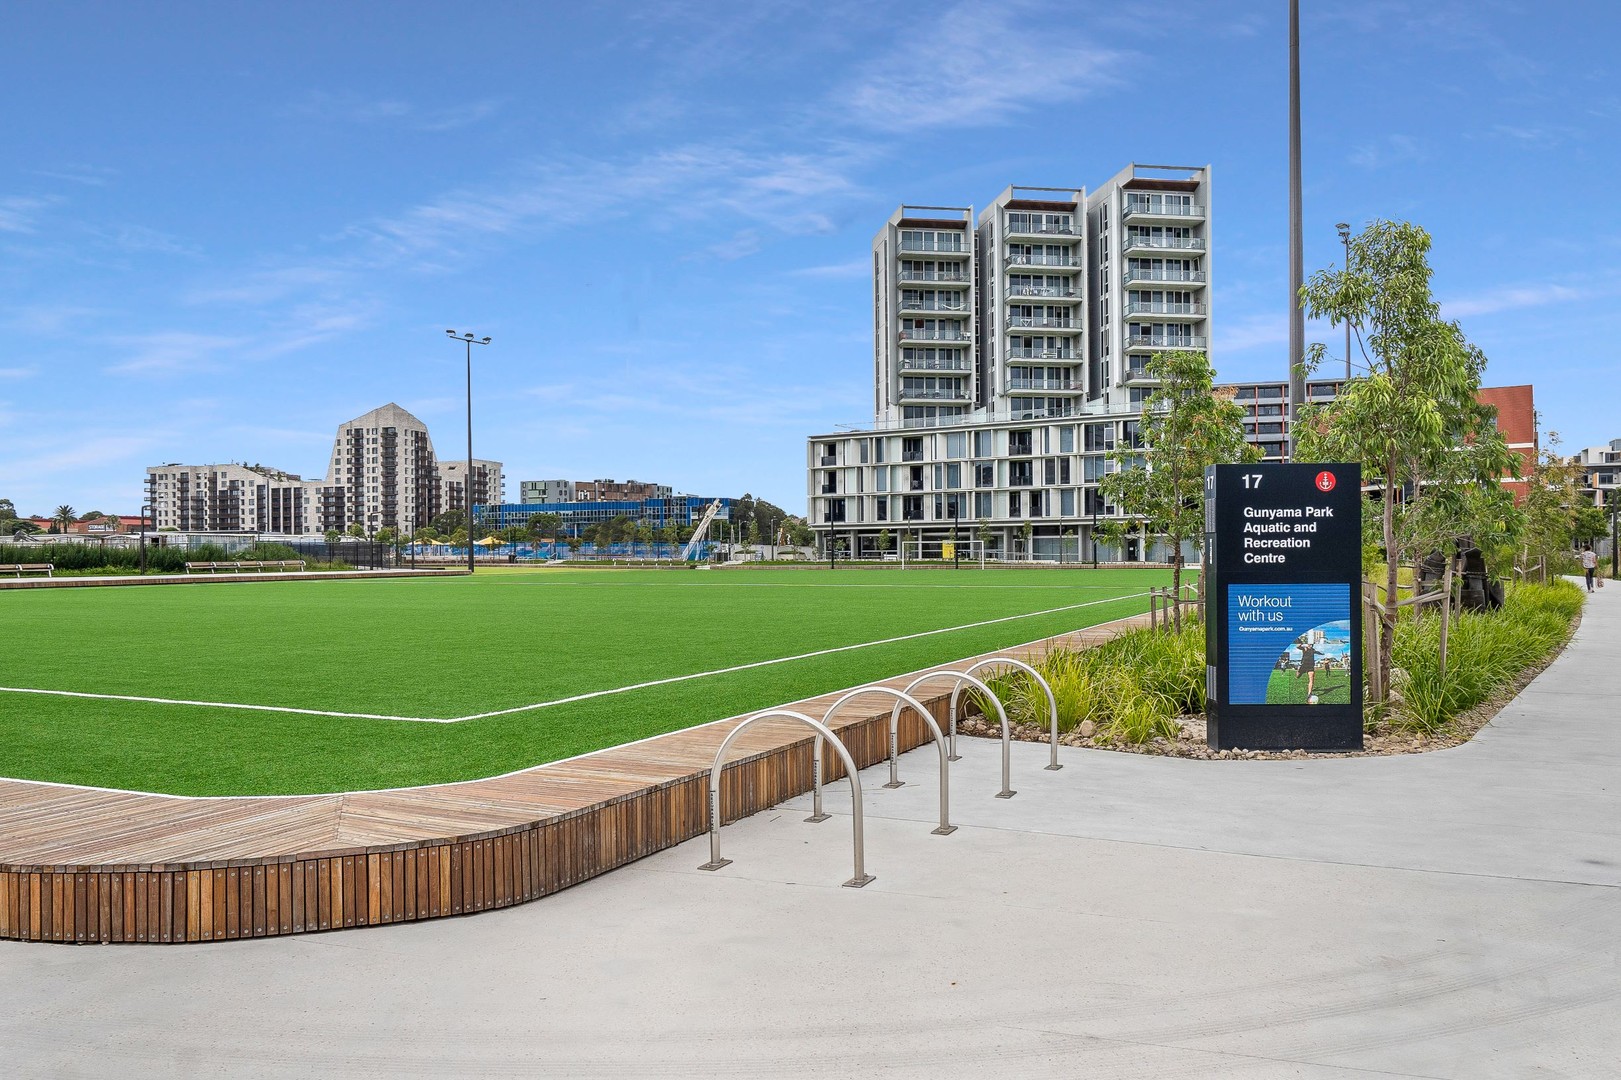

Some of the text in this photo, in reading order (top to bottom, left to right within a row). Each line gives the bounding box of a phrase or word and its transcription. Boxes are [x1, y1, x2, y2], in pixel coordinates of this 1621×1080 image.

[1206, 475, 1214, 490] 17
[1241, 474, 1263, 489] 17
[1243, 506, 1334, 520] Gunyama Park
[1243, 521, 1317, 536] Aquatic and
[1244, 537, 1311, 548] Recreation
[1243, 552, 1286, 563] Centre
[1237, 594, 1292, 607] Workout
[1237, 609, 1284, 621] with us
